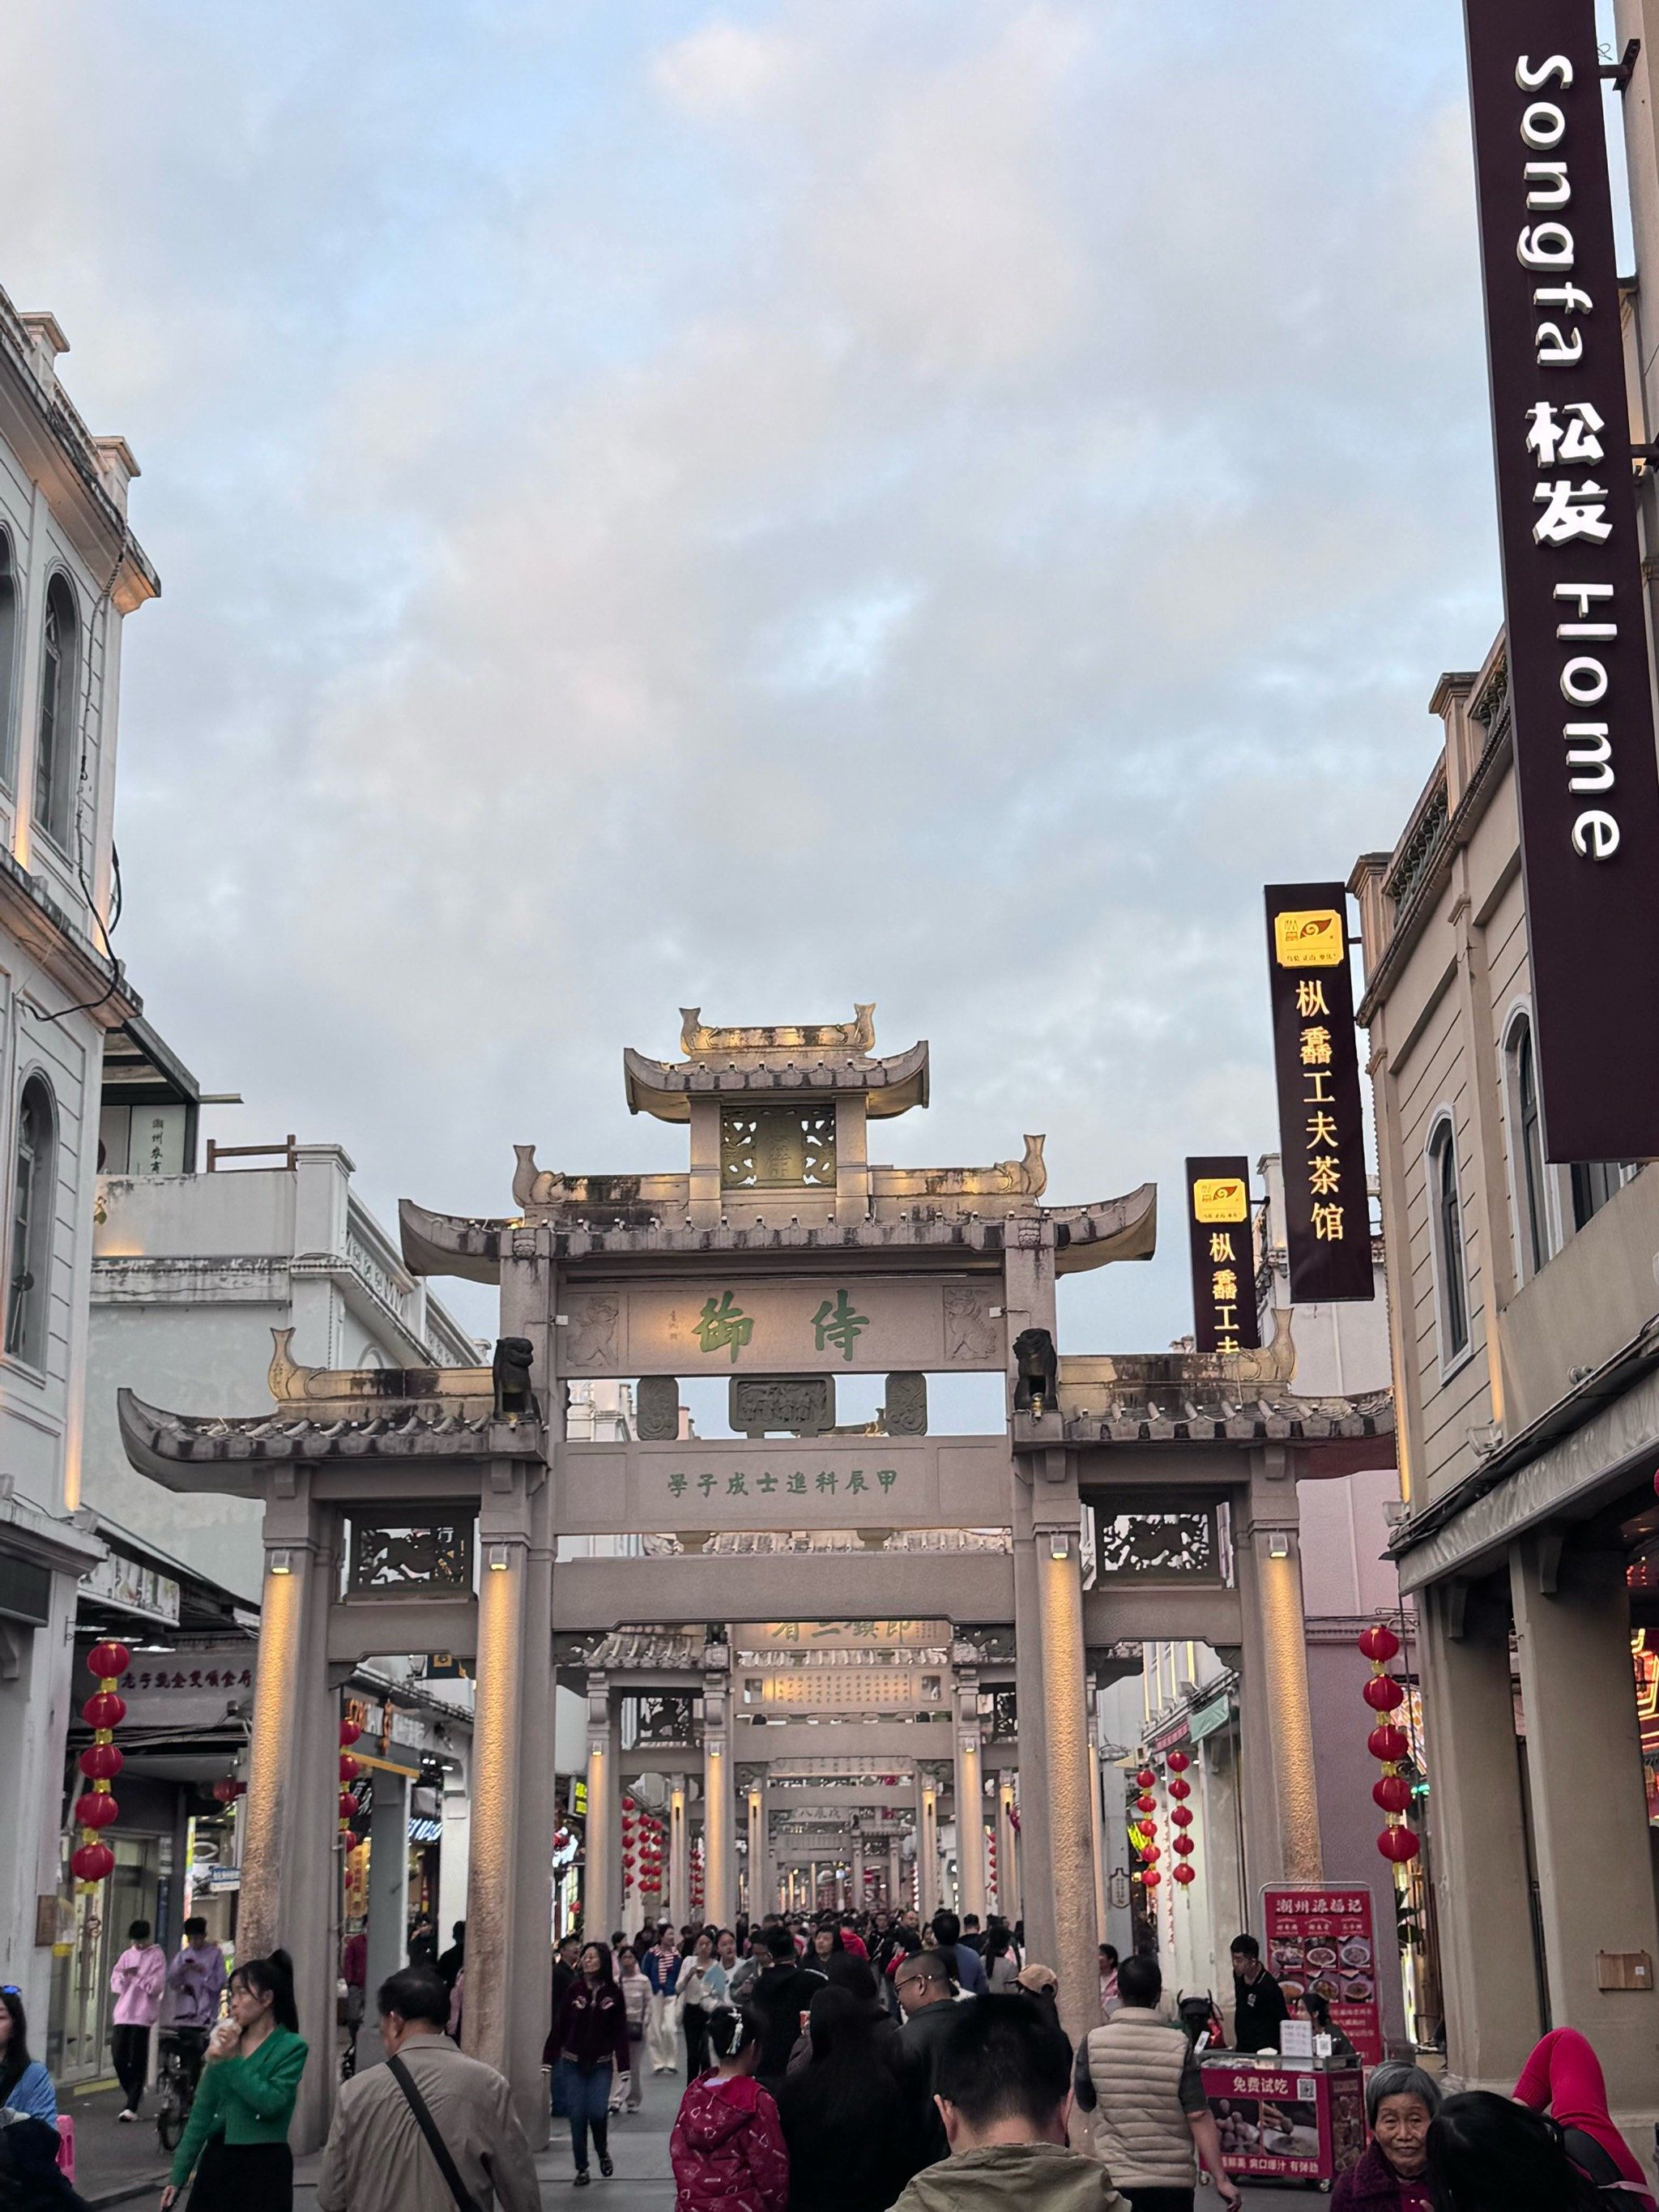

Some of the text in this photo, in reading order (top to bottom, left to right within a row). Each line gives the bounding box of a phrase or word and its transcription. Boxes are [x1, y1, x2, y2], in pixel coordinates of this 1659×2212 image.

[1516, 55, 1620, 861] Songfa 松发 Home
[1233, 2075, 1289, 2095] 免费试吃
